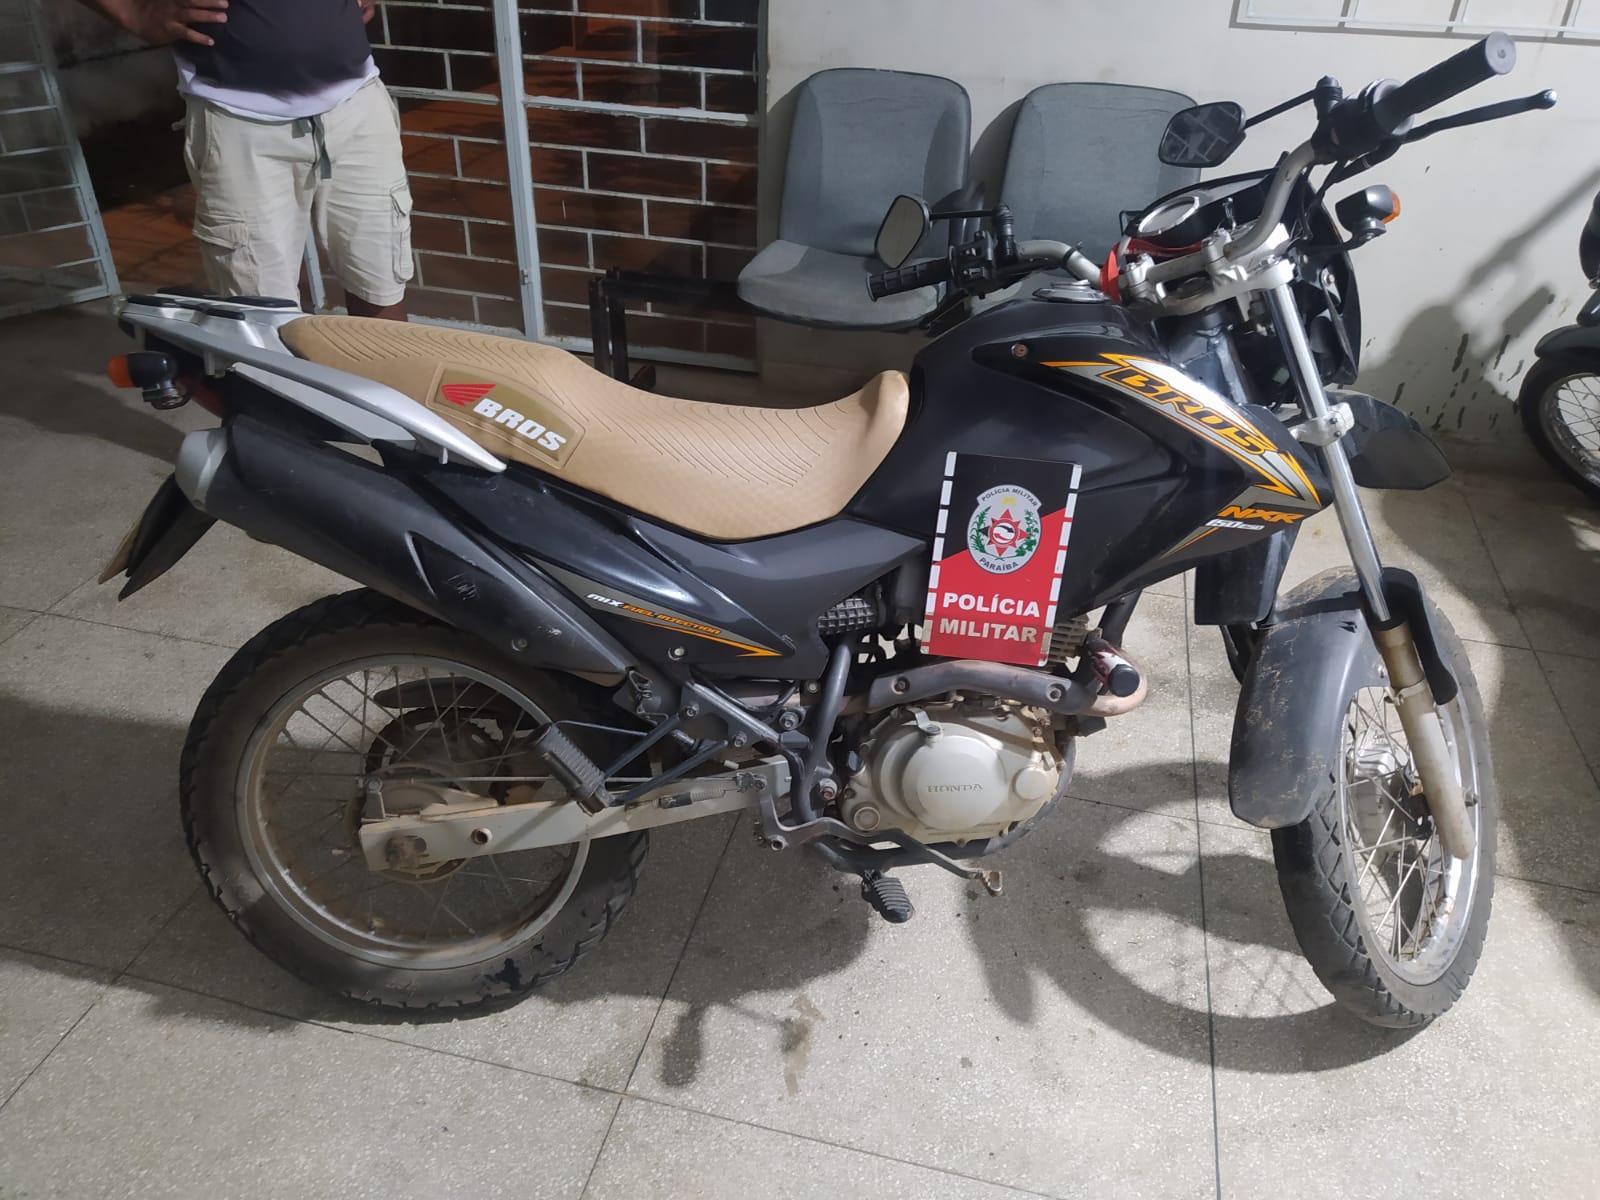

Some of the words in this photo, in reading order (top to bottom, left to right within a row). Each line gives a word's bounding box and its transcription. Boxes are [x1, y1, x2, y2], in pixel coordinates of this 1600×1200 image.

[1099, 366, 1266, 455] BROS
[473, 398, 567, 451] BROS
[981, 487, 1010, 502] POLÍCIA
[1012, 488, 1038, 507] MILITAR
[1216, 505, 1305, 524] NXR
[979, 556, 1019, 571] PARAÍBA
[942, 592, 1040, 617] POLÍCIA
[939, 618, 1038, 643] MILITAR
[927, 783, 984, 793] HONDA
